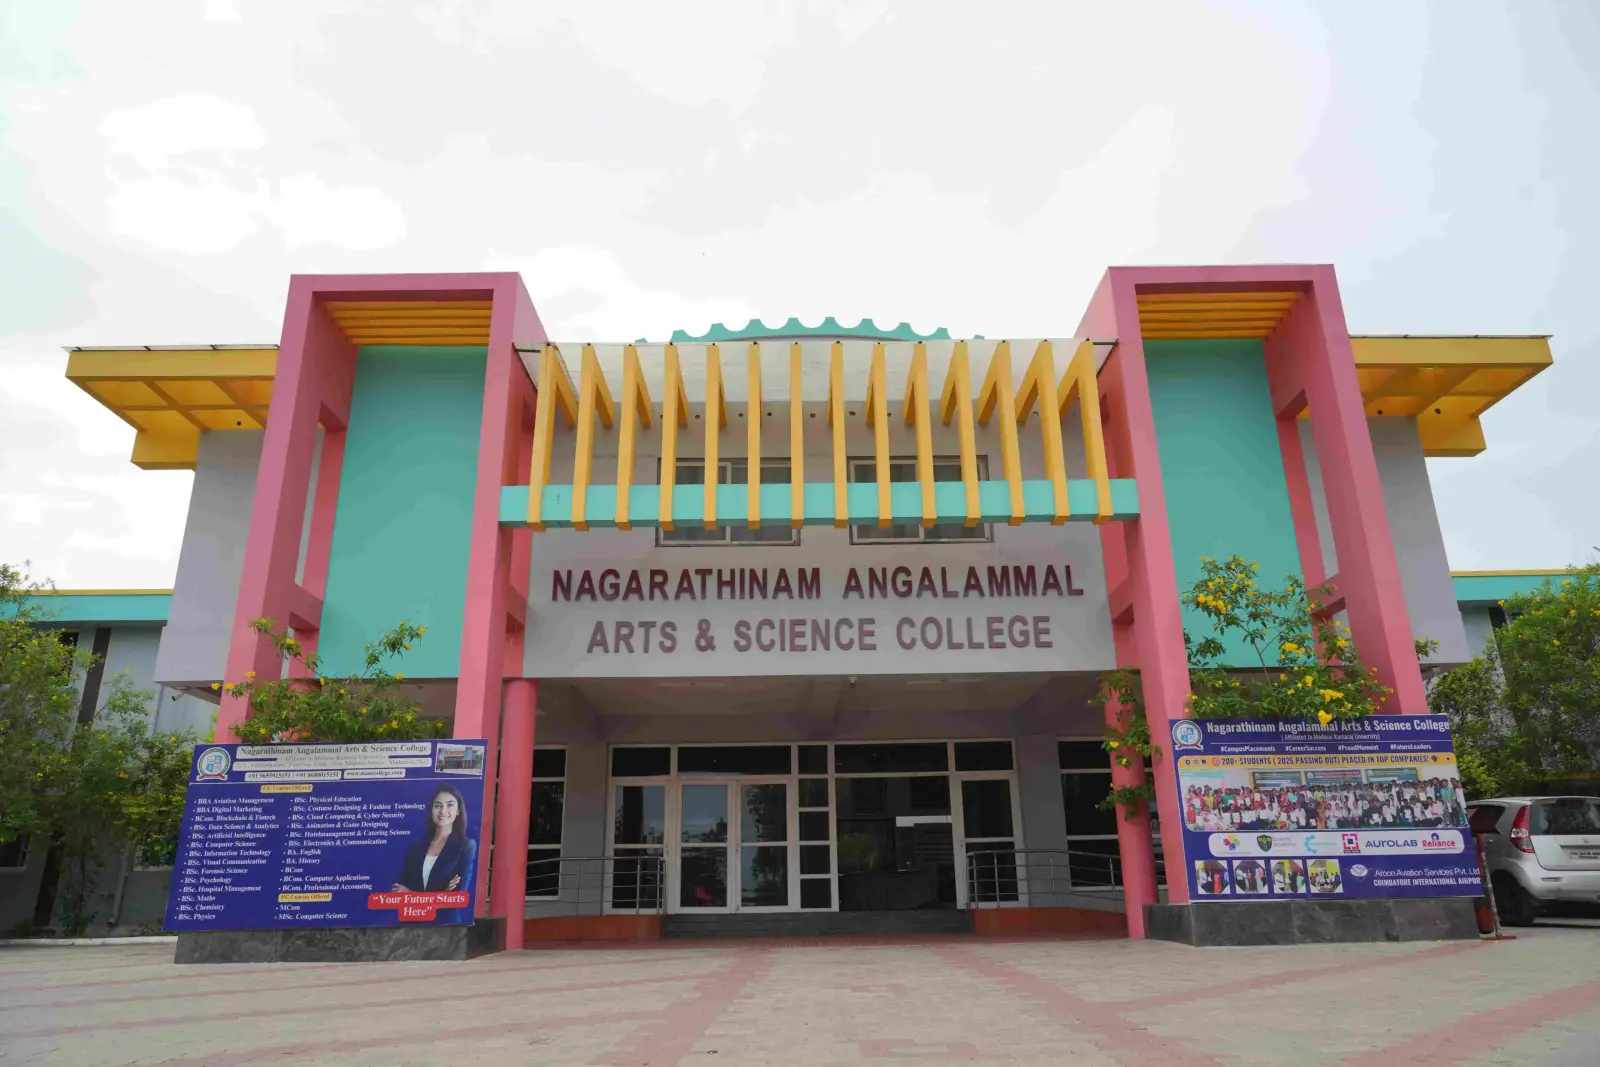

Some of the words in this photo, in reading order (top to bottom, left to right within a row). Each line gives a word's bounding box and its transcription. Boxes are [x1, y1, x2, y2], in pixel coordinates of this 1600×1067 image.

[552, 568, 821, 602] NAGARATHINAM
[843, 564, 1084, 599] ANGALAMMAL
[587, 620, 677, 654] ARTS
[695, 619, 715, 651] &
[734, 617, 876, 652] SCIENCE
[896, 615, 1053, 649] COLLEGE
[1207, 722, 1275, 734] Nagarathinam
[1342, 720, 1360, 731] Arts
[1365, 721, 1371, 731] &
[1374, 720, 1411, 731] Science
[1414, 720, 1450, 732] College
[241, 747, 293, 755] Nagarathinam
[296, 744, 342, 754] Angalammal
[344, 744, 359, 752] Arts
[371, 744, 397, 752] Science
[400, 743, 428, 752] College
[1296, 756, 1323, 764] PASSING
[1325, 756, 1340, 764] OUT)
[1422, 839, 1456, 847] Reliance
[404, 894, 434, 903] Future
[436, 894, 465, 902] Starts
